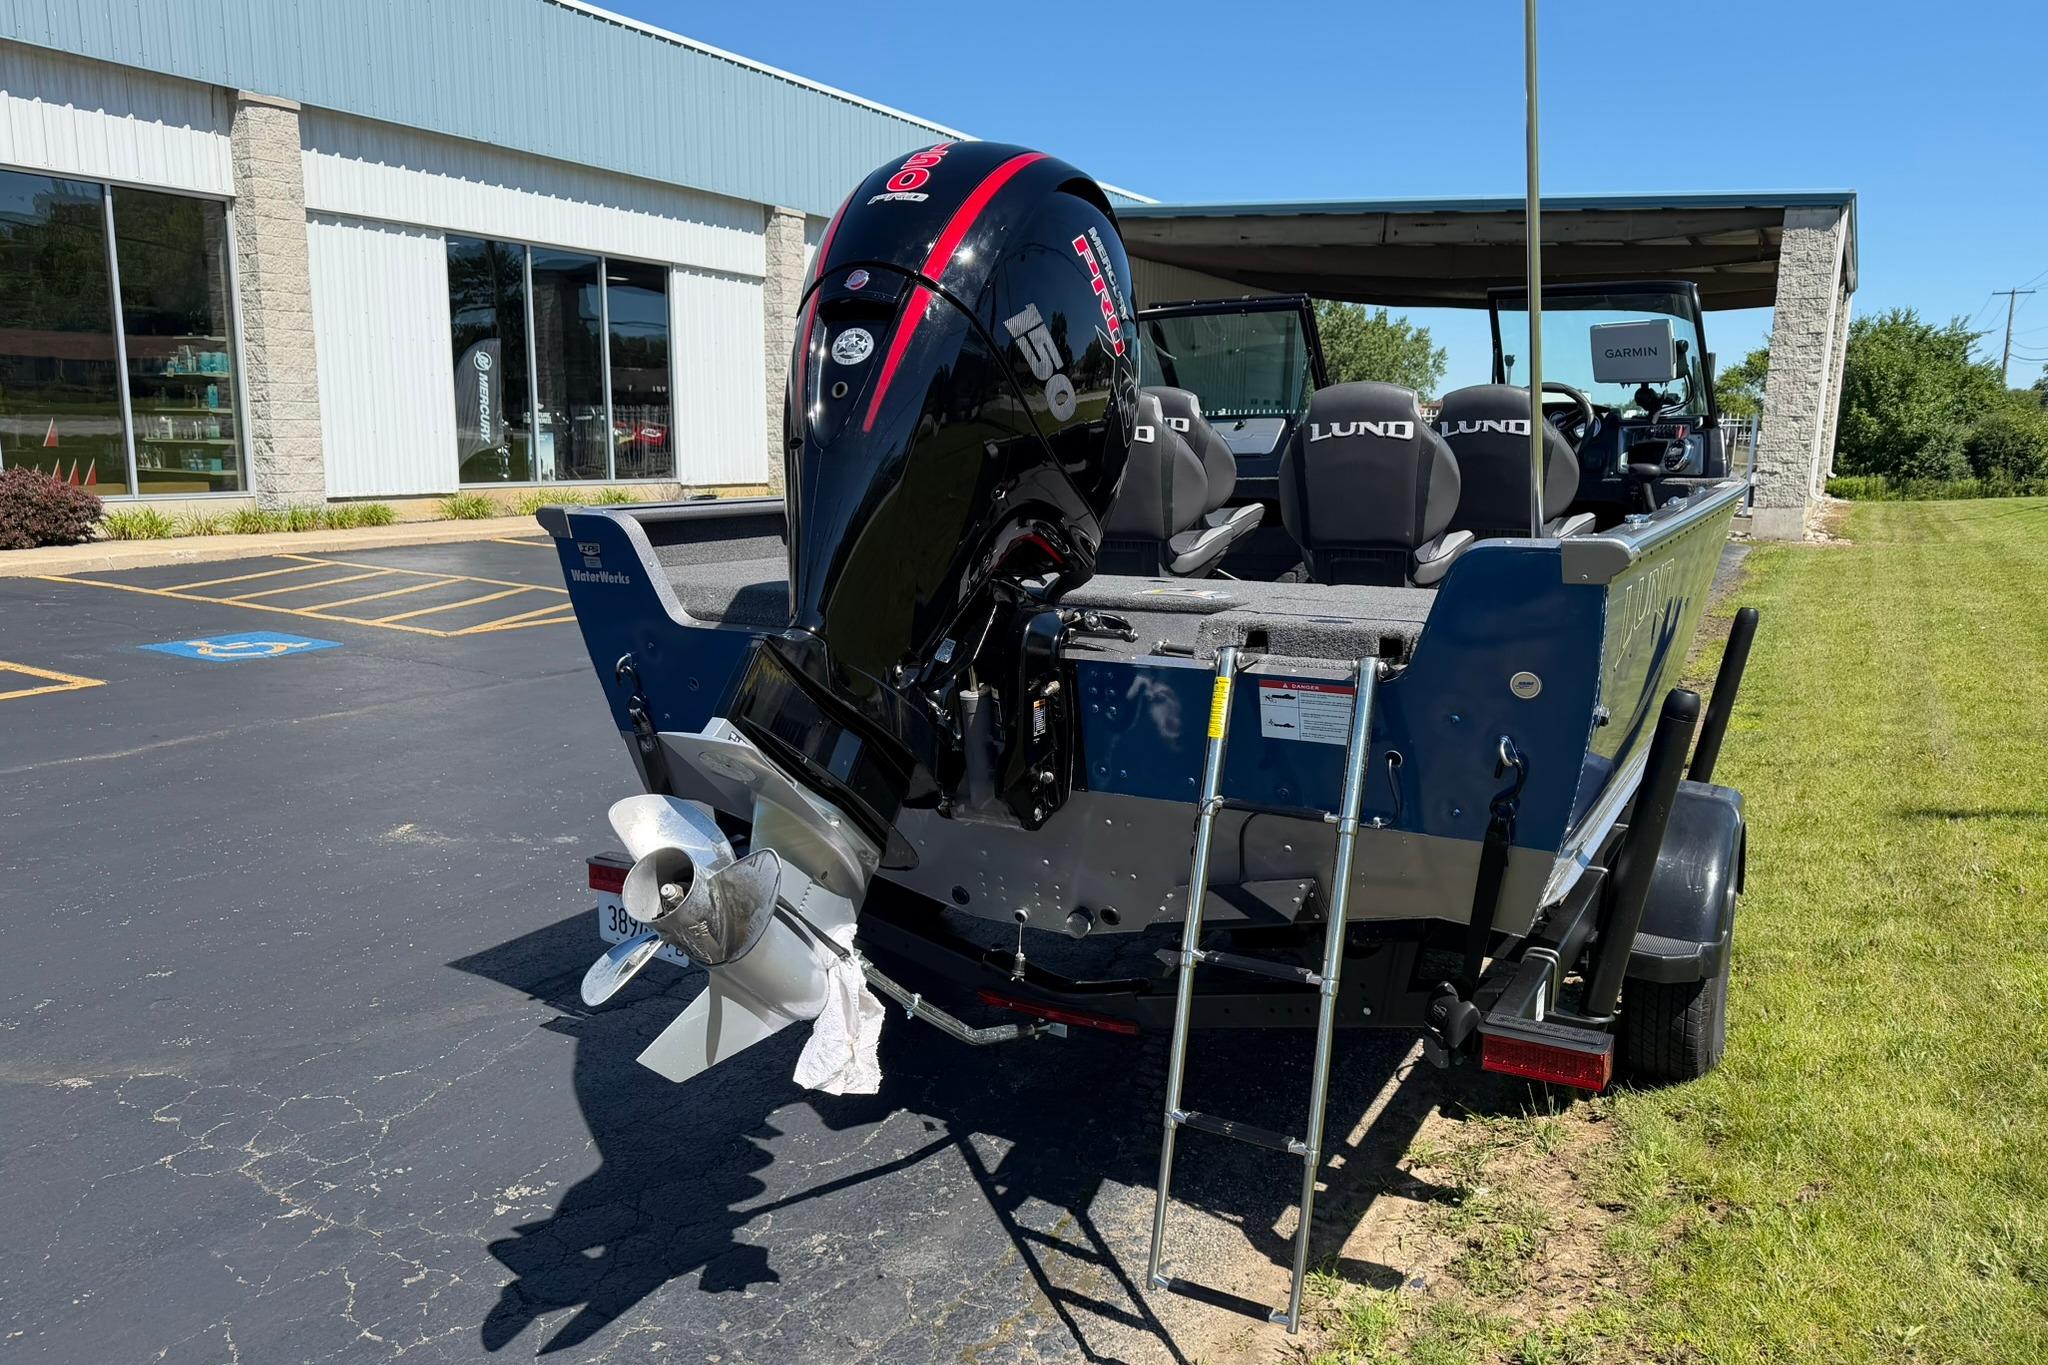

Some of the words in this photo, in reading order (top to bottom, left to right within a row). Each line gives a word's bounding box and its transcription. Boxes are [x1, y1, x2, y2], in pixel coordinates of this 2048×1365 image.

[1072, 234, 1126, 357] PRO
[1088, 226, 1129, 320] MERCURY
[1003, 303, 1076, 421] 150
[1604, 347, 1658, 359] GARMIN
[478, 372, 491, 444] MERCURY
[1440, 420, 1531, 437] LUND
[1310, 421, 1414, 442] LUND
[1291, 683, 1320, 691] DANGER
